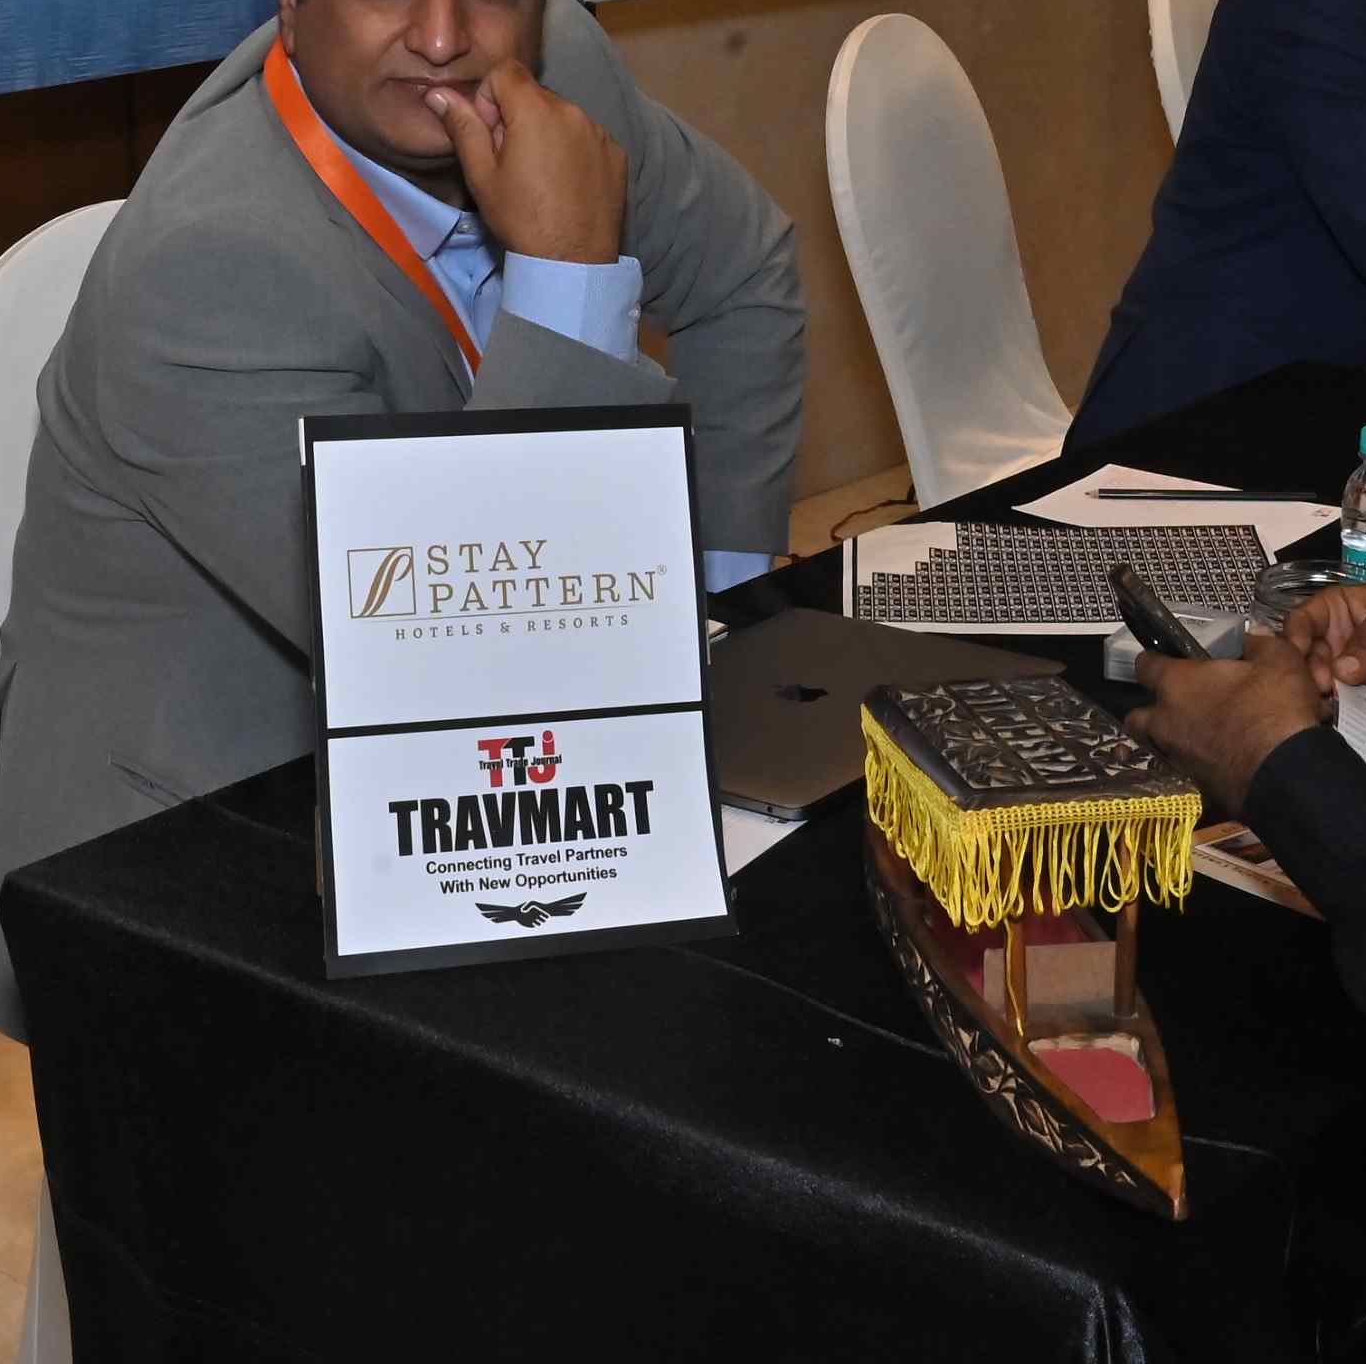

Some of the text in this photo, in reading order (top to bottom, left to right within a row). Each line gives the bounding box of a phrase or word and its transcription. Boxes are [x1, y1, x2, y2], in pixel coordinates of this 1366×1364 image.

[427, 539, 547, 576] STAY
[396, 614, 629, 640] HOTELS & RESORTS
[388, 780, 654, 857] TRAVMART
[426, 845, 628, 875] Connecting Travel Partners
[440, 866, 617, 894] With New Opportunities
